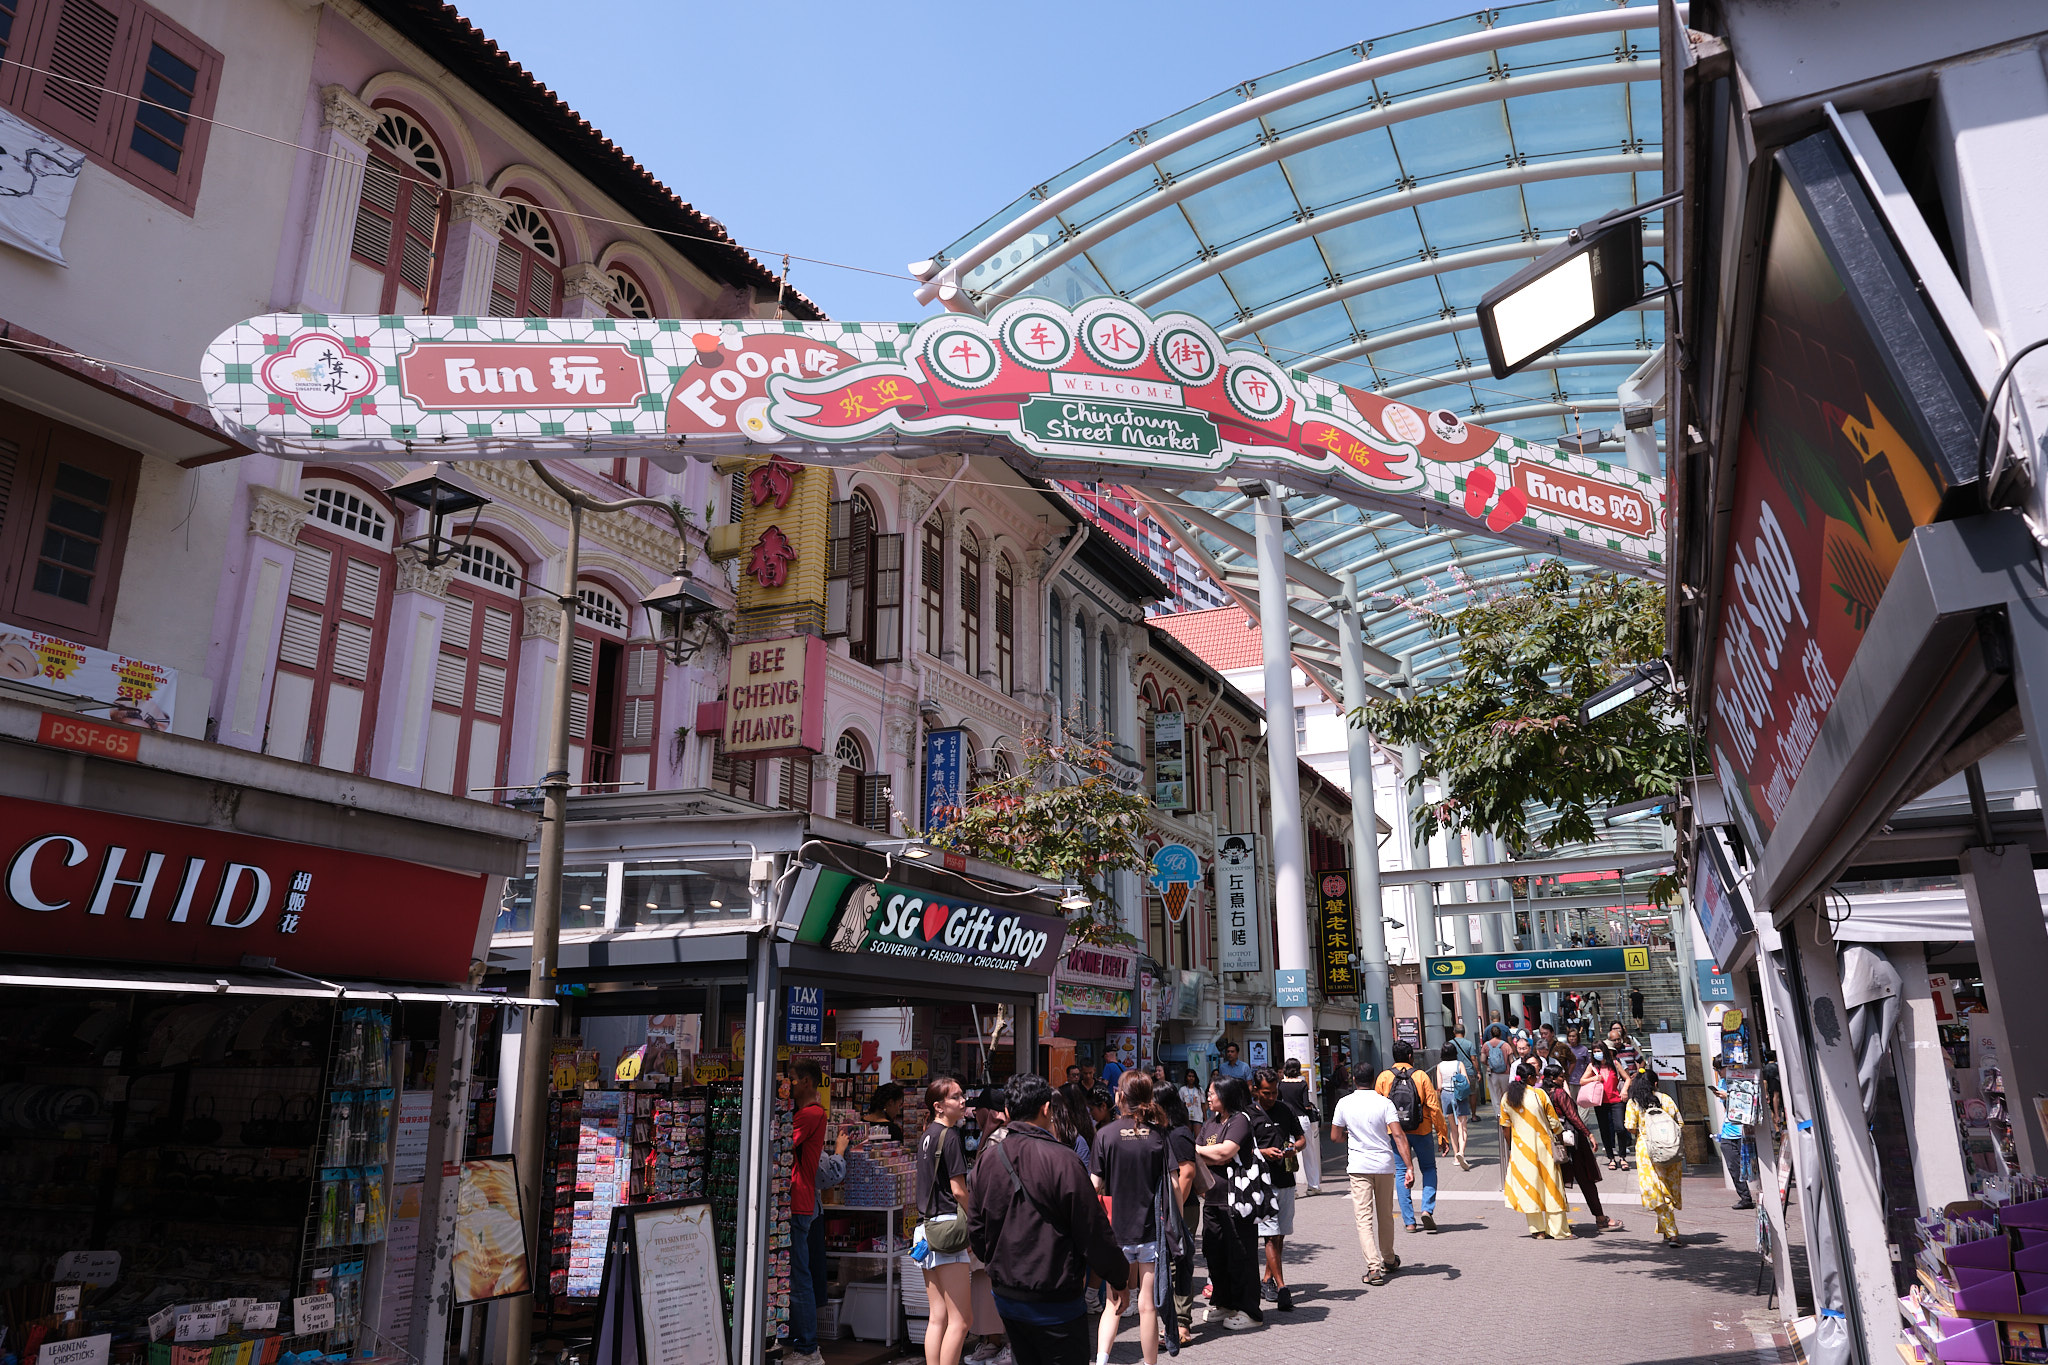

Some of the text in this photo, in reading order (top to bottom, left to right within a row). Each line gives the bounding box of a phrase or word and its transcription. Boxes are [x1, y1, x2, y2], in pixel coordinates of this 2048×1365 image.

[318, 349, 349, 395] 牛车水
[803, 347, 840, 376] 吃
[444, 355, 606, 395] Fun 玩
[838, 378, 915, 419] 欢迎
[1064, 378, 1174, 400] WELCOME
[1061, 402, 1185, 433] Chinatown
[1046, 419, 1200, 451] Street Market
[1317, 427, 1371, 467] 光临
[1525, 471, 1643, 526] Finds 购
[32, 631, 86, 651] Eyebrow
[1716, 500, 1809, 774] The Gift Shop
[28, 640, 86, 664] Trimming
[749, 647, 785, 675] BEE
[45, 664, 65, 680] $6
[111, 664, 168, 684] Extension
[119, 655, 164, 674] Eyelash
[1802, 639, 1836, 711] Gift
[117, 685, 153, 701] $38+
[733, 680, 798, 710] CHENG
[51, 721, 129, 753] PSSF-65
[732, 714, 794, 744] HIANG
[950, 736, 958, 767] CHINESE
[277, 869, 314, 934] 胡姬花
[879, 893, 1048, 968] SG Gift Shop
[1324, 899, 1351, 983] 蟹老宋酒楼
[538, 957, 546, 976] 1
[870, 940, 1019, 971] SOUVENIR FASHION CHOCOLATE
[1500, 962, 1506, 970] NE
[1536, 958, 1592, 970] Chinatown
[1632, 954, 1641, 964] A
[793, 986, 818, 1004] TAX
[1286, 994, 1299, 1002] 入口
[790, 1005, 819, 1016] REFUND
[560, 1070, 568, 1086] $1
[622, 1060, 633, 1077] $1
[696, 1068, 702, 1078] 2
[712, 1068, 726, 1078] $10
[900, 1062, 914, 1076] $1
[180, 1314, 192, 1322] PIG
[192, 1304, 203, 1312] DOG
[302, 1314, 312, 1324] $5
[48, 1340, 88, 1356] LEARNING
[53, 1349, 95, 1365] CHOPSTICKS
